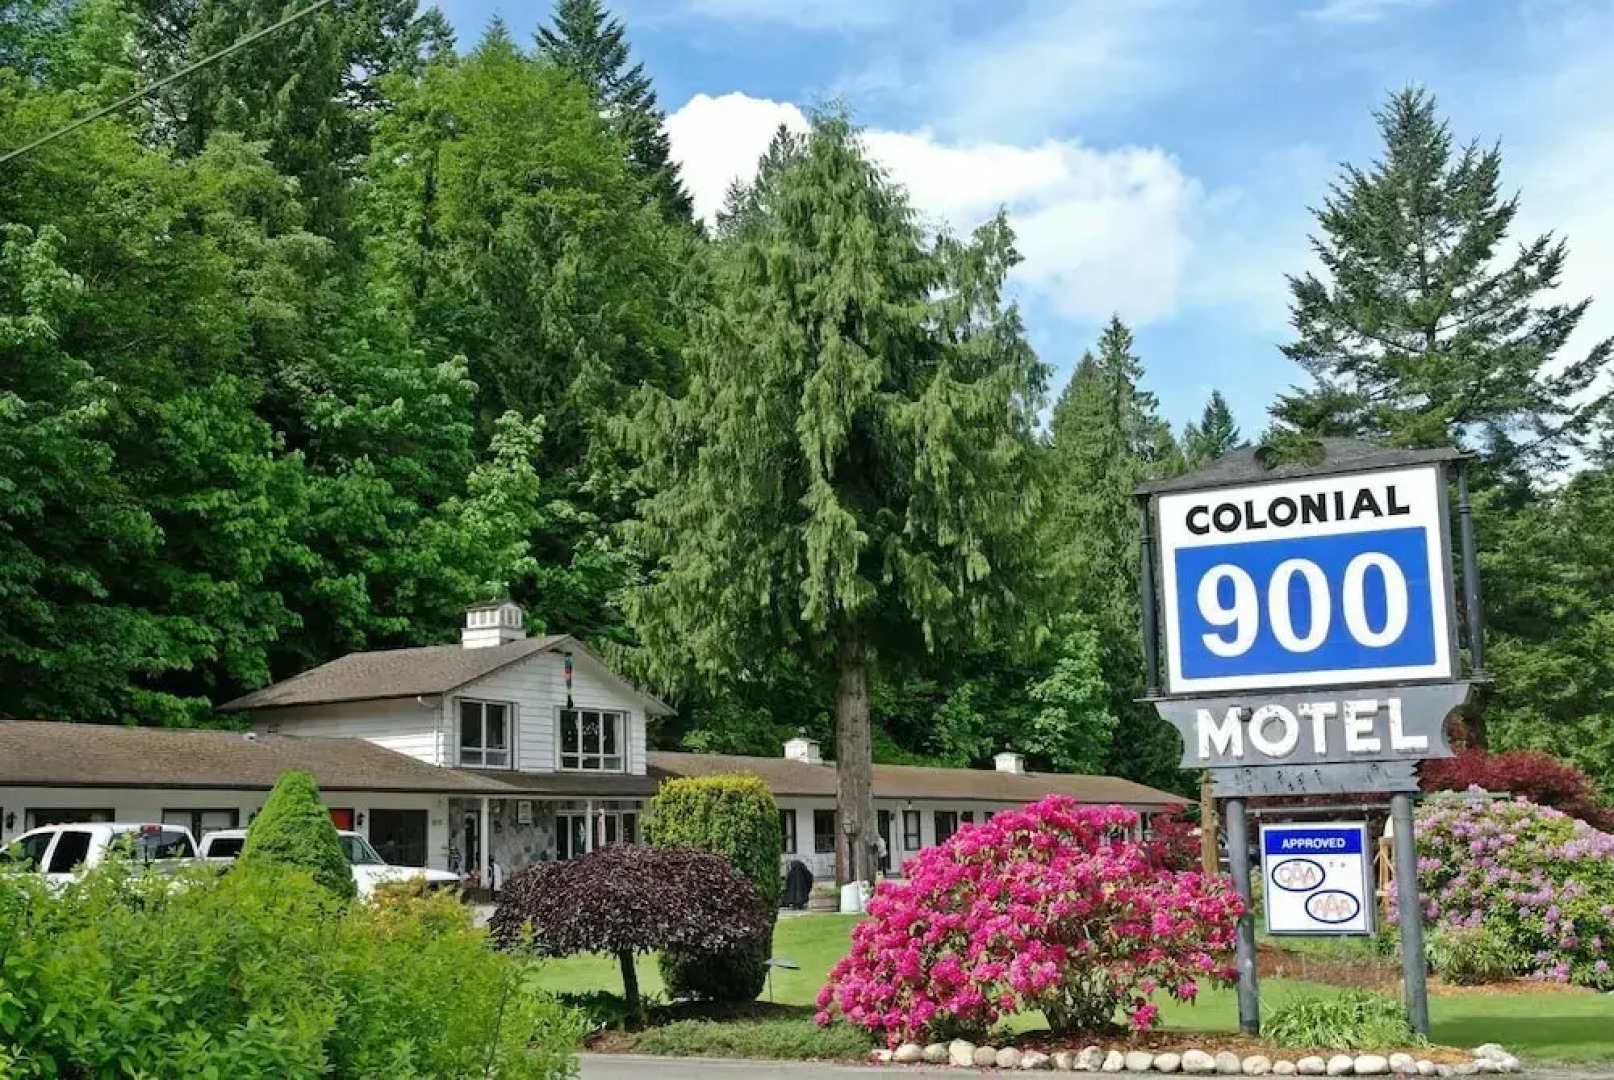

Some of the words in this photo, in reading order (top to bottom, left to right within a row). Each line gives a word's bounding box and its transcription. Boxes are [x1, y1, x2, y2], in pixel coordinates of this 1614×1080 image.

[1185, 485, 1410, 535] COLONIAL
[1196, 551, 1409, 658] 900
[1195, 698, 1429, 759] MOTEL
[1281, 837, 1346, 850] APPROVED
